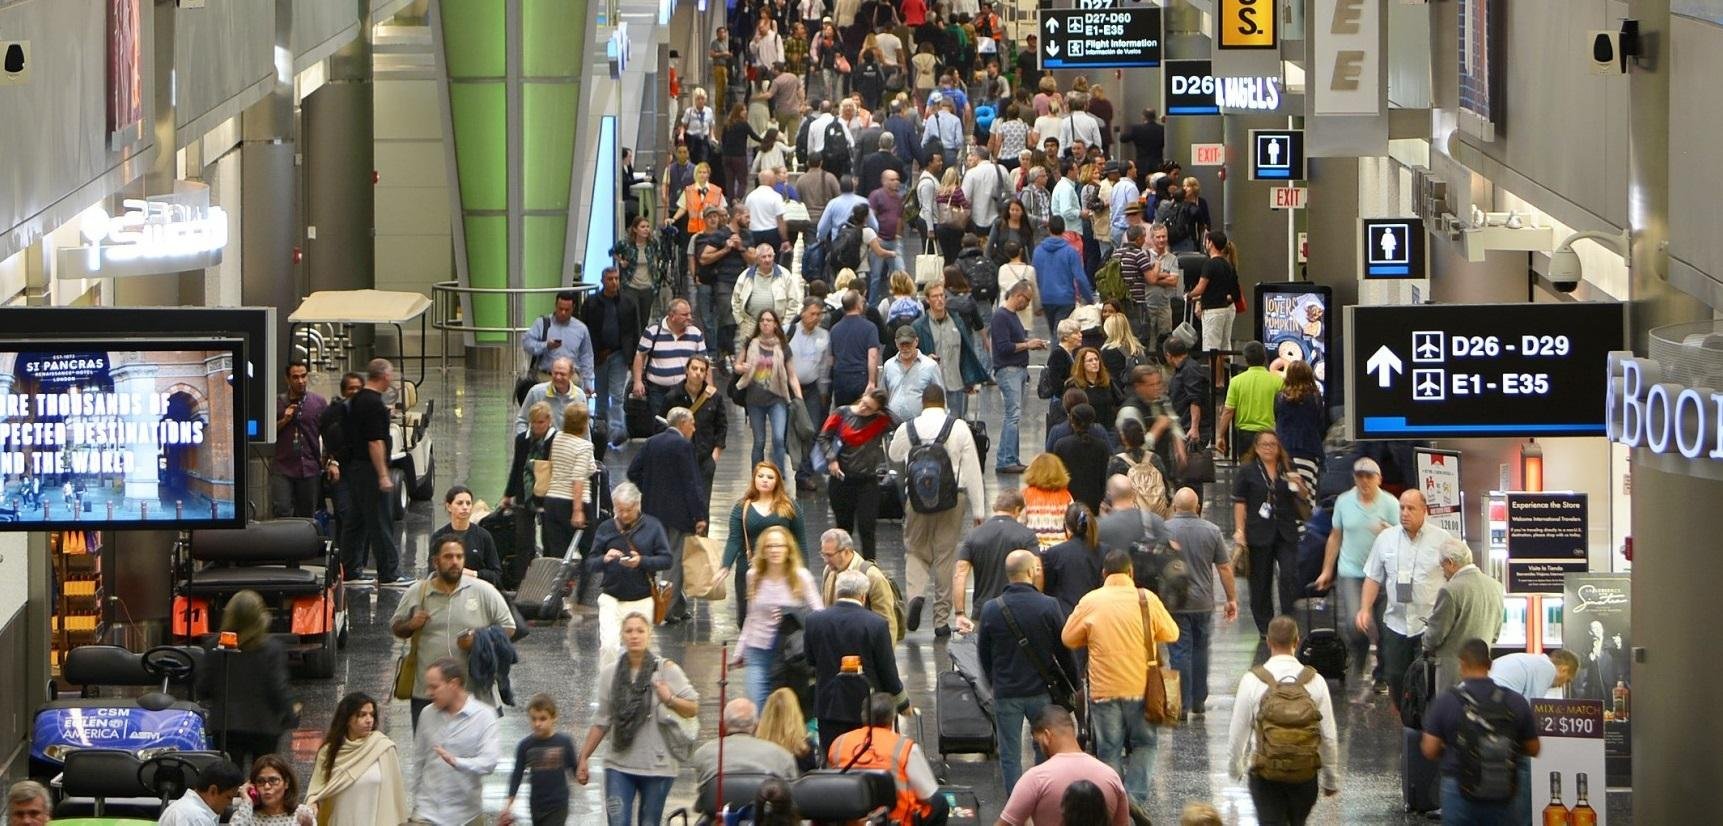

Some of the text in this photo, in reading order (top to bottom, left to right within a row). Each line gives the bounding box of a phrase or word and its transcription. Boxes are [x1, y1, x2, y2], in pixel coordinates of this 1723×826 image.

[1085, 13, 1131, 24] D27-D60
[1085, 25, 1124, 36] E1-E35
[1085, 39, 1157, 50] Flight Information
[1171, 76, 1214, 95] D26
[1198, 148, 1219, 162] EXIT
[1277, 189, 1300, 206] EXIT
[1452, 336, 1499, 357] D26
[1522, 335, 1569, 356] D29
[44, 359, 104, 371] PANCRAS
[1452, 374, 1480, 394] E1
[1503, 374, 1548, 394] E35
[36, 392, 142, 416] THOUSANDS
[149, 392, 171, 414] OF
[74, 420, 203, 444] DESTINATIONS
[32, 451, 65, 473] THE
[71, 450, 134, 473] WORLD
[1512, 501, 1549, 510] Experience
[98, 708, 130, 717] CSM
[1535, 704, 1553, 713] MIX
[1566, 705, 1600, 715] MATCH
[62, 728, 120, 739] AMERICA
